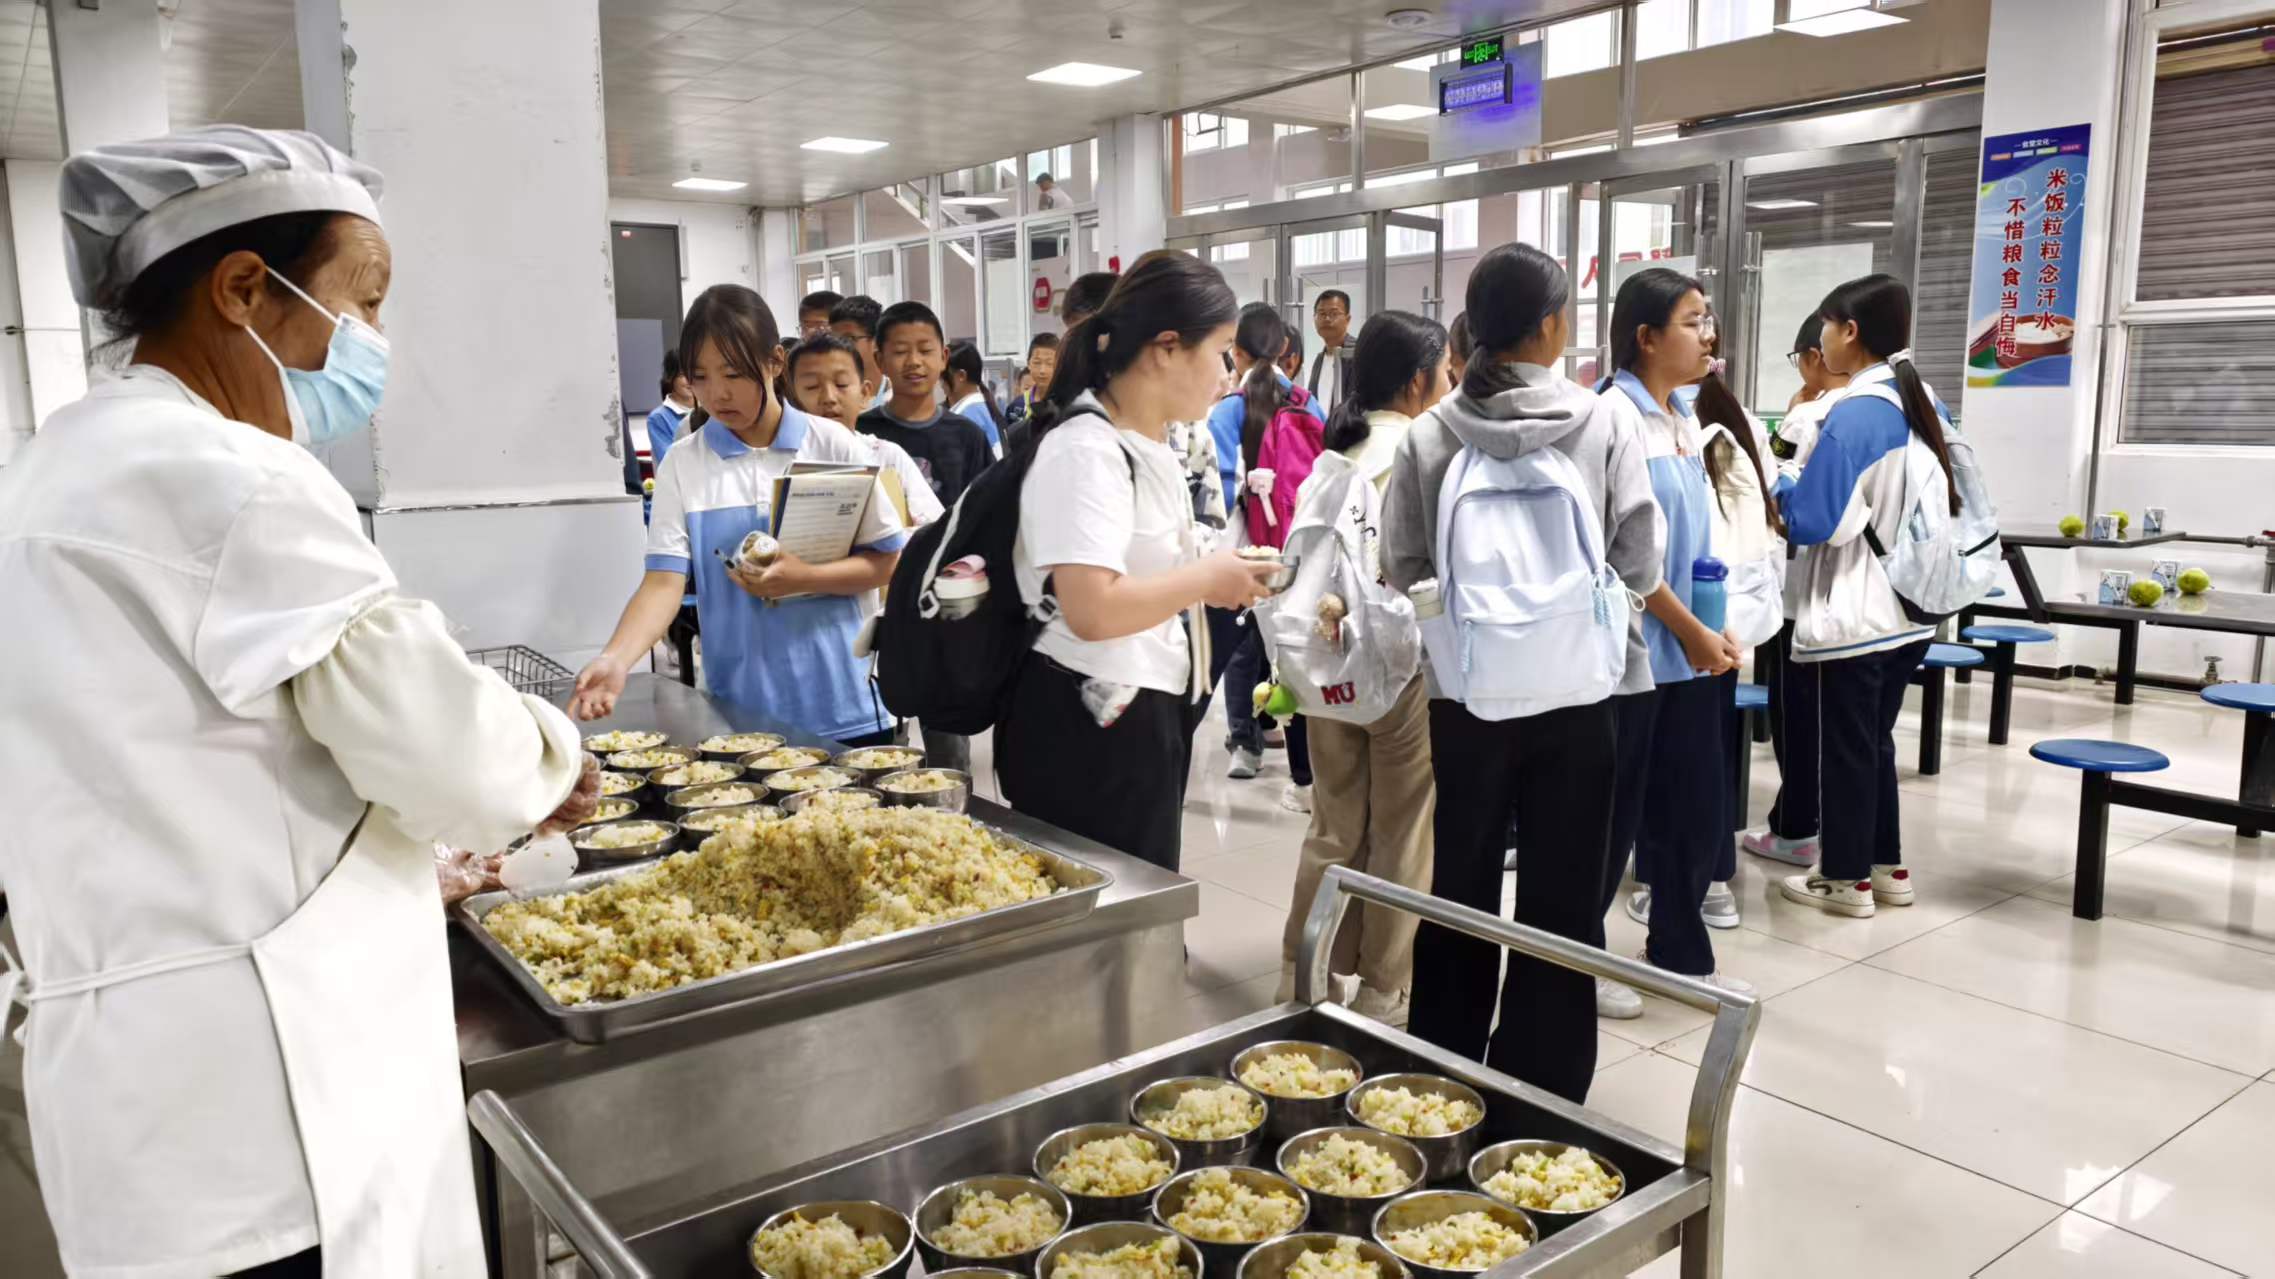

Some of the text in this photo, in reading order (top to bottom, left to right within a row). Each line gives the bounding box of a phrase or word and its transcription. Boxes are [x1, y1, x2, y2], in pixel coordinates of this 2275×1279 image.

[1996, 197, 2027, 356] 不惜粮食当自悔
[2034, 168, 2068, 331] 米饭粒粒念汗水
